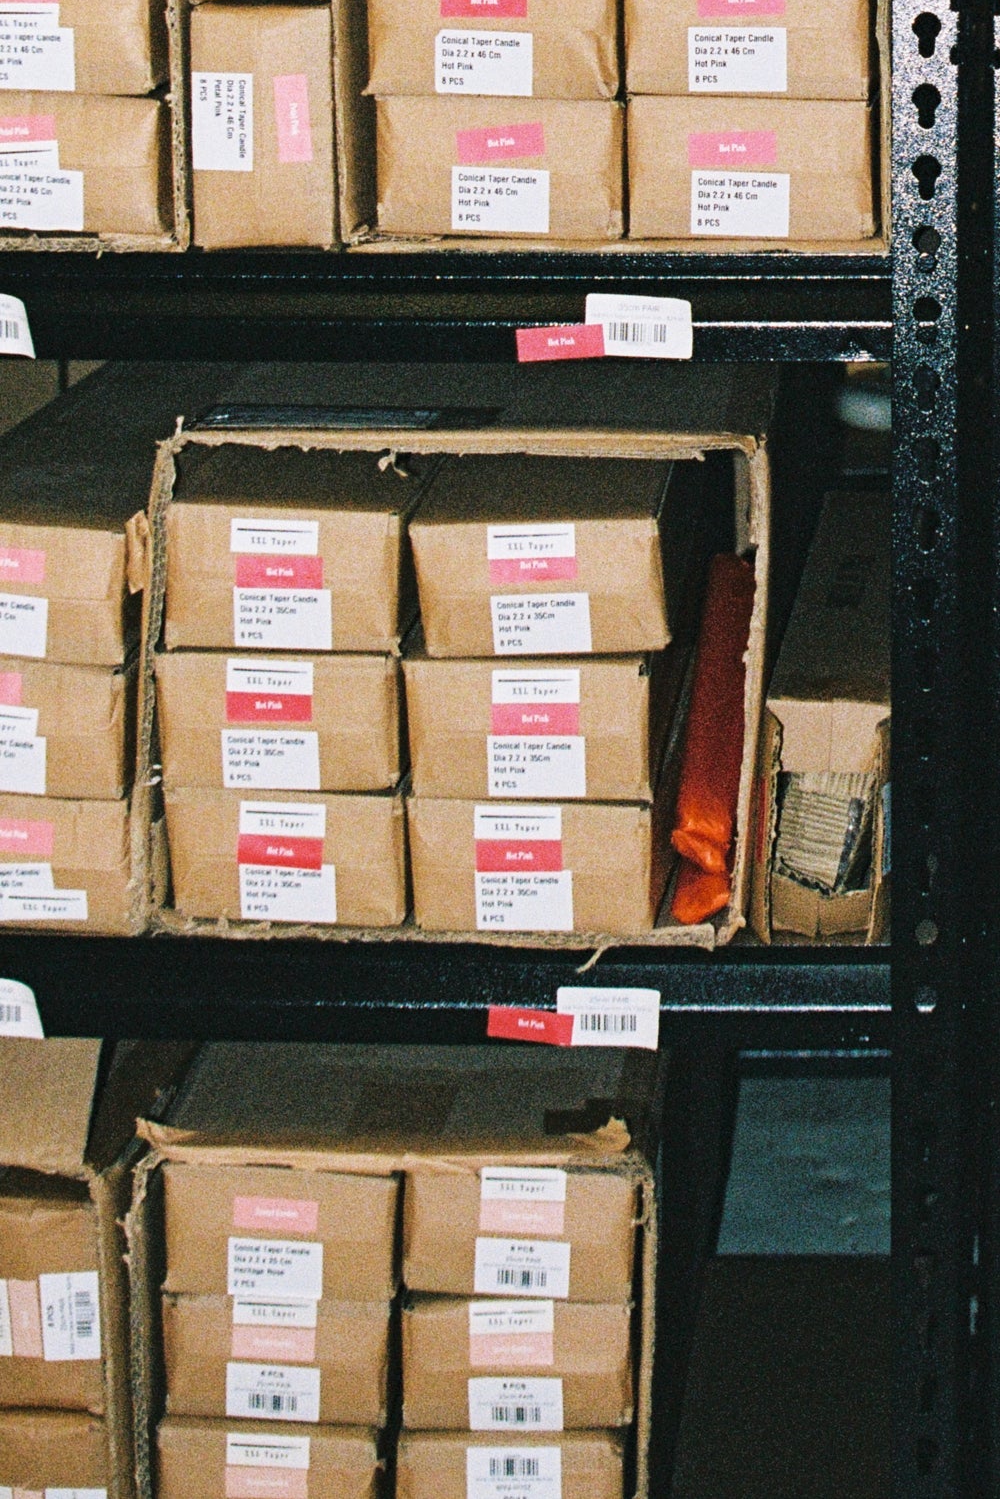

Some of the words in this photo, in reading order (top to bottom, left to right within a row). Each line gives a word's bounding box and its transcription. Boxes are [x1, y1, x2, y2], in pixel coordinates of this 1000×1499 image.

[547, 338, 560, 347] Hot
[560, 337, 575, 346] Pink
[265, 567, 278, 576] Hot
[278, 567, 294, 577] Pink
[255, 617, 272, 626] Pink
